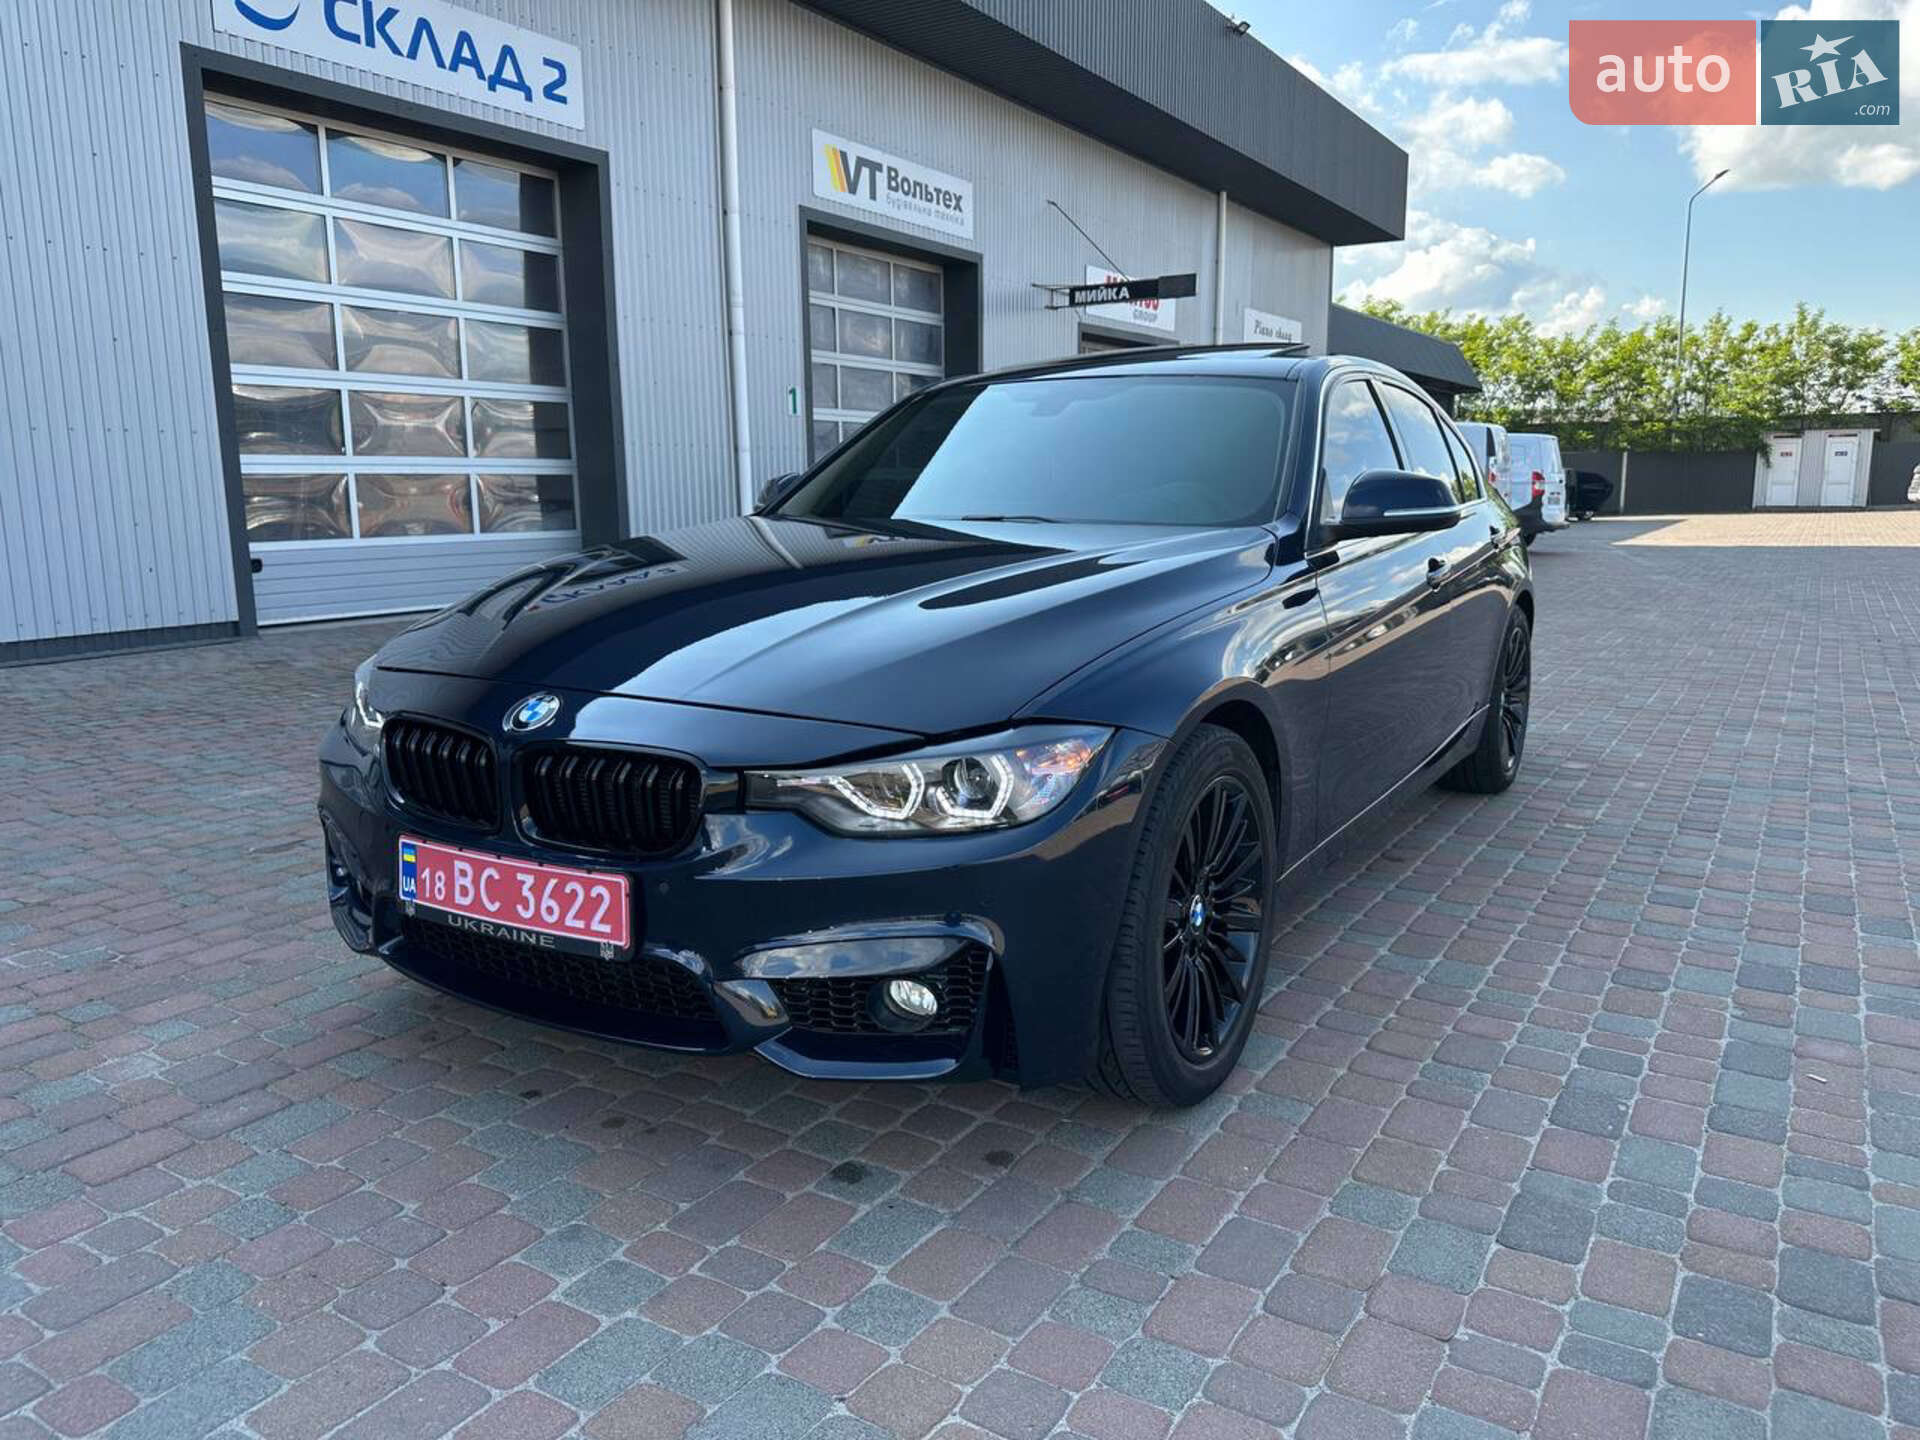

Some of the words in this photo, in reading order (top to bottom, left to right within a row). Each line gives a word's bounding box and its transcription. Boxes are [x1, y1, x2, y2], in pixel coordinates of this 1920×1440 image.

[323, 0, 533, 101] СКЛАД
[542, 57, 567, 104] 2
[886, 165, 963, 213] Вольтех
[1075, 286, 1130, 304] МИЙКА
[789, 387, 797, 415] 1
[402, 875, 417, 893] UA
[421, 867, 446, 901] 18
[454, 860, 501, 912] BC
[516, 872, 612, 934] 3622
[448, 914, 556, 949] UKRAINE
